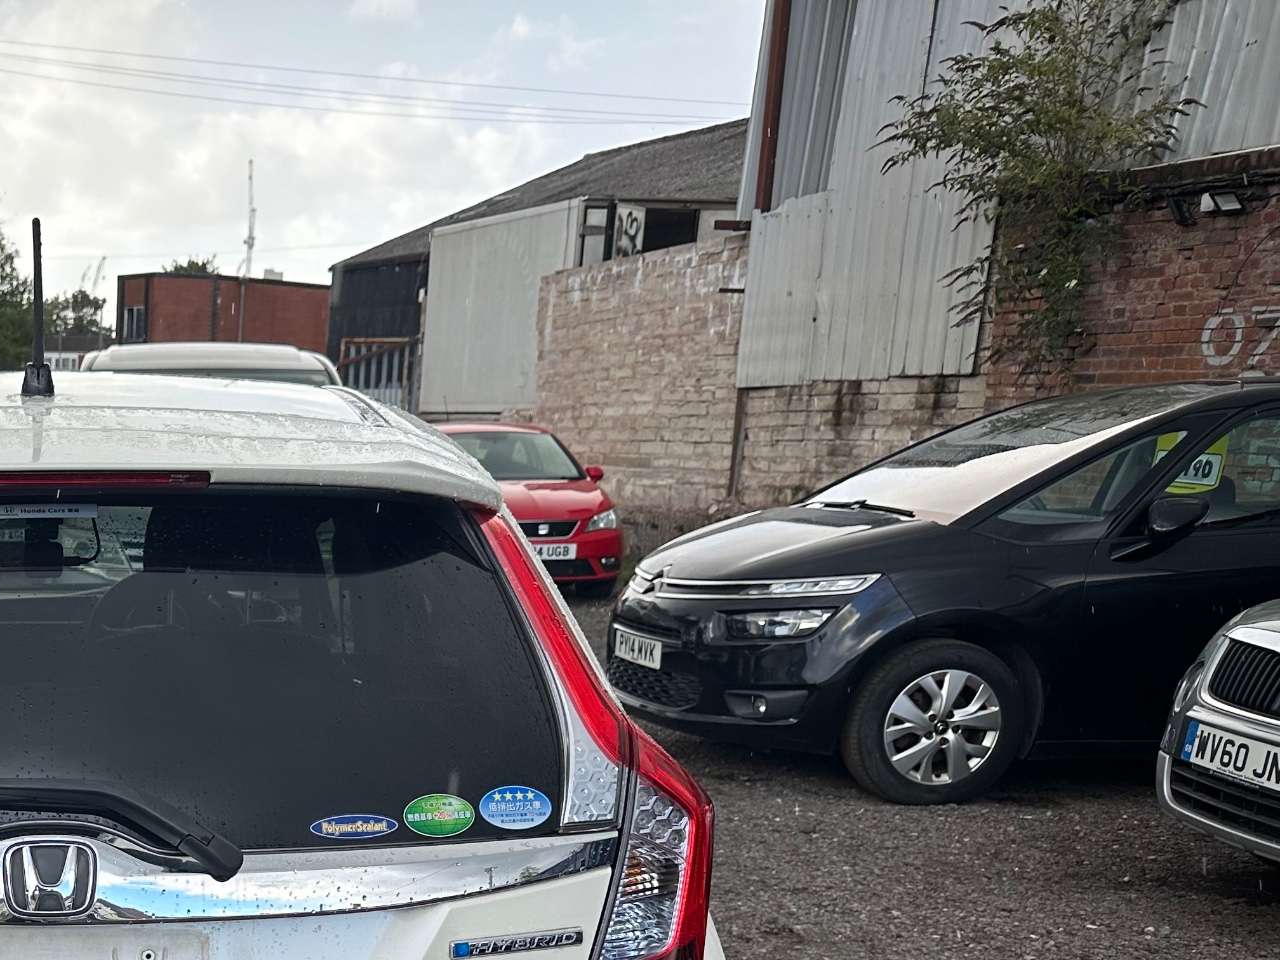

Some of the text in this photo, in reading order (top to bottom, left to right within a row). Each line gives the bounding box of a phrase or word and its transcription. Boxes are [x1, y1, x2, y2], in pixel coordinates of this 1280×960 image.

[547, 546, 569, 557] UGB
[620, 631, 656, 664] PY14 MVK
[1195, 730, 1250, 772] WV60
[471, 931, 577, 955] HYBRID
